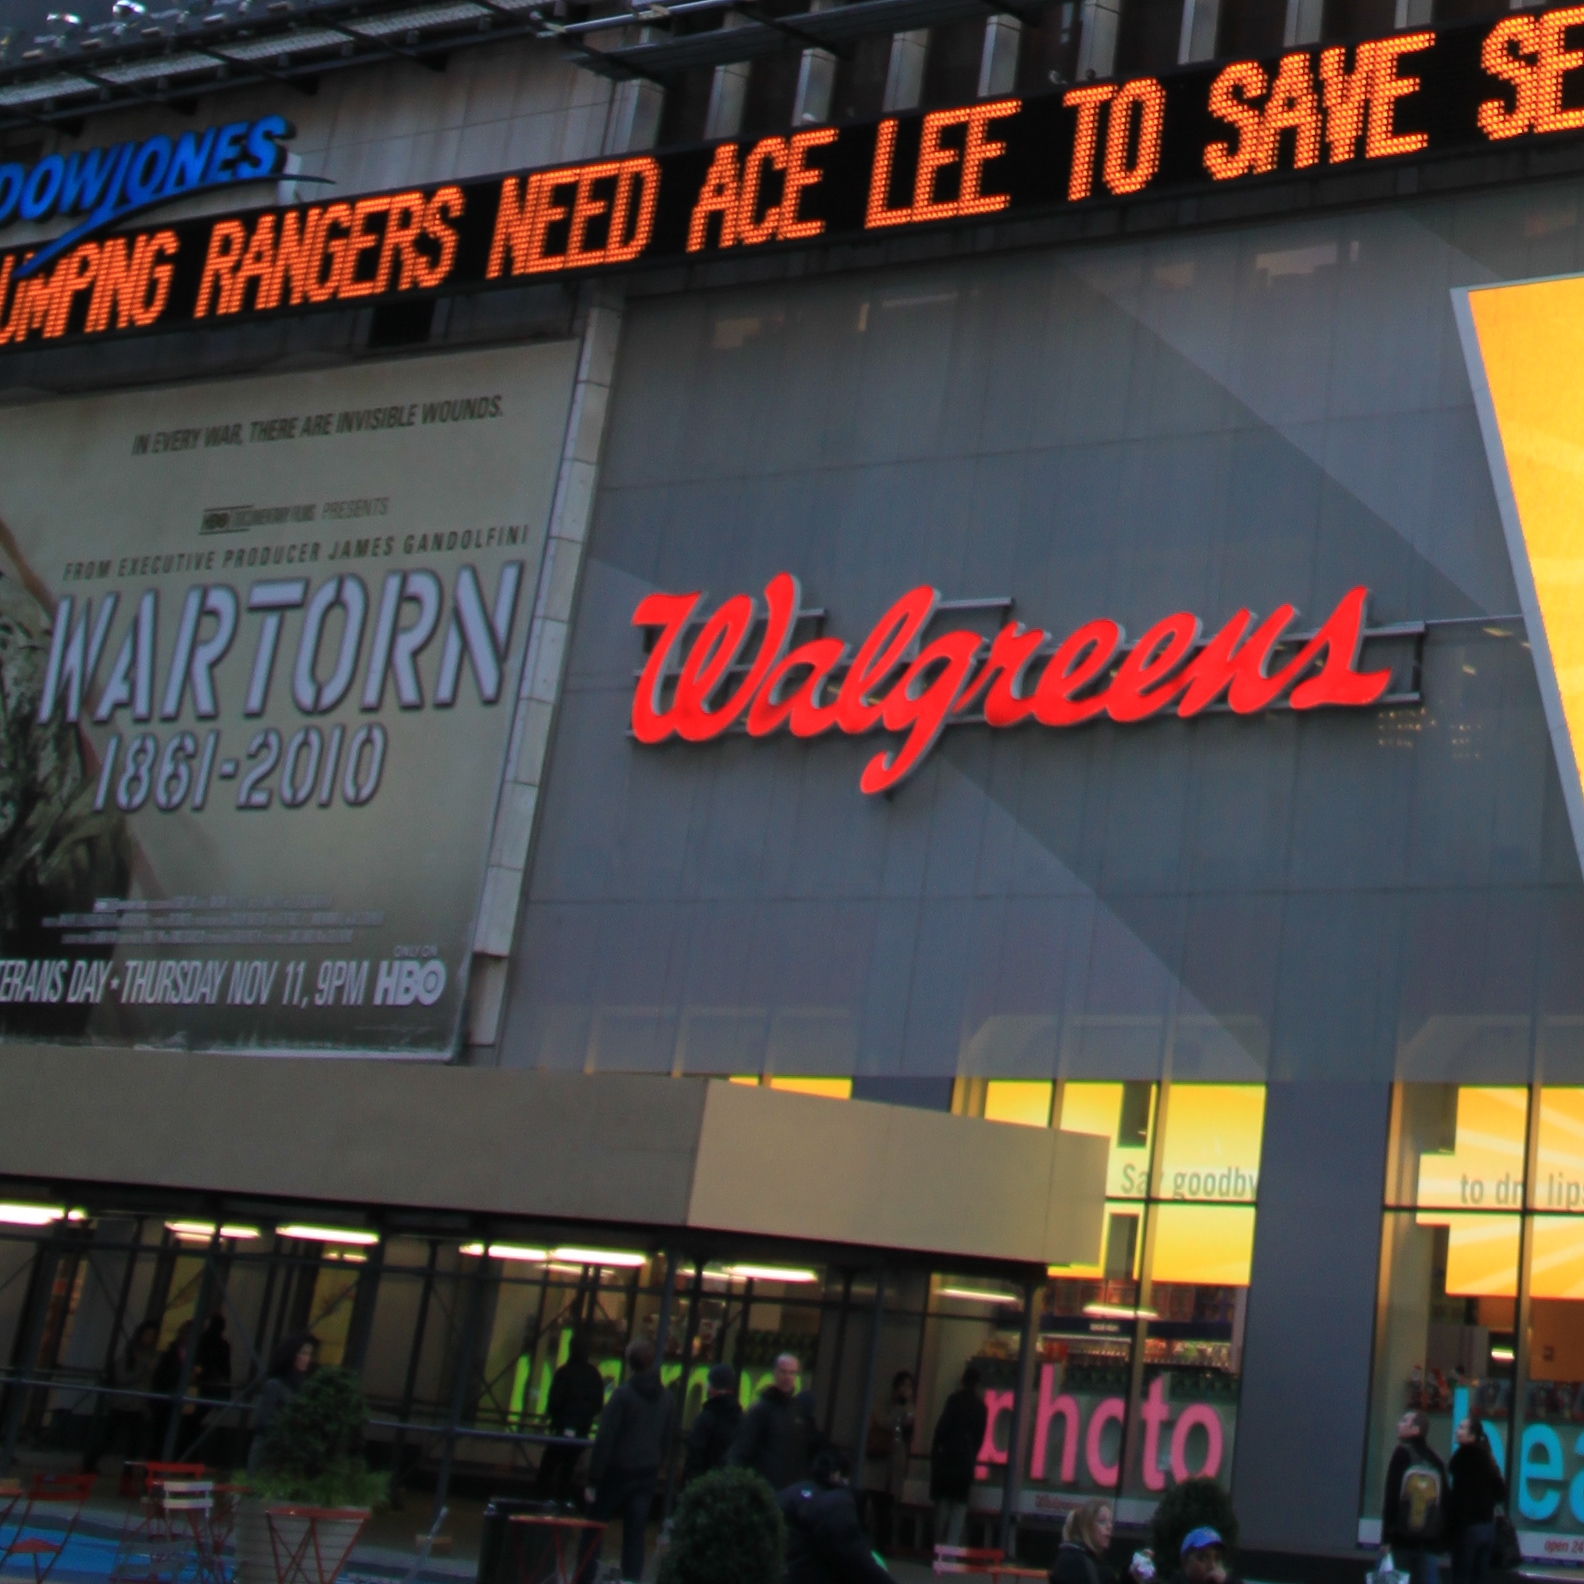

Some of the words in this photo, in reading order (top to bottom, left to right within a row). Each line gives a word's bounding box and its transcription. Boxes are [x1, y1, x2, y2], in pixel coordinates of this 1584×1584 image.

[194, 186, 465, 319] RANGERS
[487, 157, 662, 281] NEED
[687, 128, 839, 254] ACE
[864, 99, 1022, 230] LEE
[1063, 76, 1167, 203] TO
[1203, 32, 1436, 181] SAVE
[131, 433, 149, 457] IN
[152, 427, 200, 454] EVERY
[249, 415, 298, 443] THERE
[300, 413, 334, 437] ARE
[335, 403, 417, 435] INVISIBLE
[421, 394, 504, 424] WOUNDS.
[322, 497, 390, 521] PRESENTS
[62, 559, 111, 581] FROM
[117, 549, 215, 576] EXECUTIVE
[223, 541, 320, 568] PRODUCER
[327, 534, 394, 561] JAMES
[402, 525, 530, 556] GANDOLFINI
[35, 560, 525, 727] WARTORN
[631, 572, 1391, 795] Walgreens
[93, 722, 389, 813] 1861-2010
[0, 959, 68, 1004] ERANS
[66, 959, 114, 1004] DAY
[121, 959, 229, 1004] THURSDAY
[226, 959, 279, 1005] NOV
[314, 959, 370, 1006] 9PM
[373, 958, 447, 1006] HBO
[1121, 1162, 1164, 1194] Sa
[1461, 1172, 1485, 1204] to
